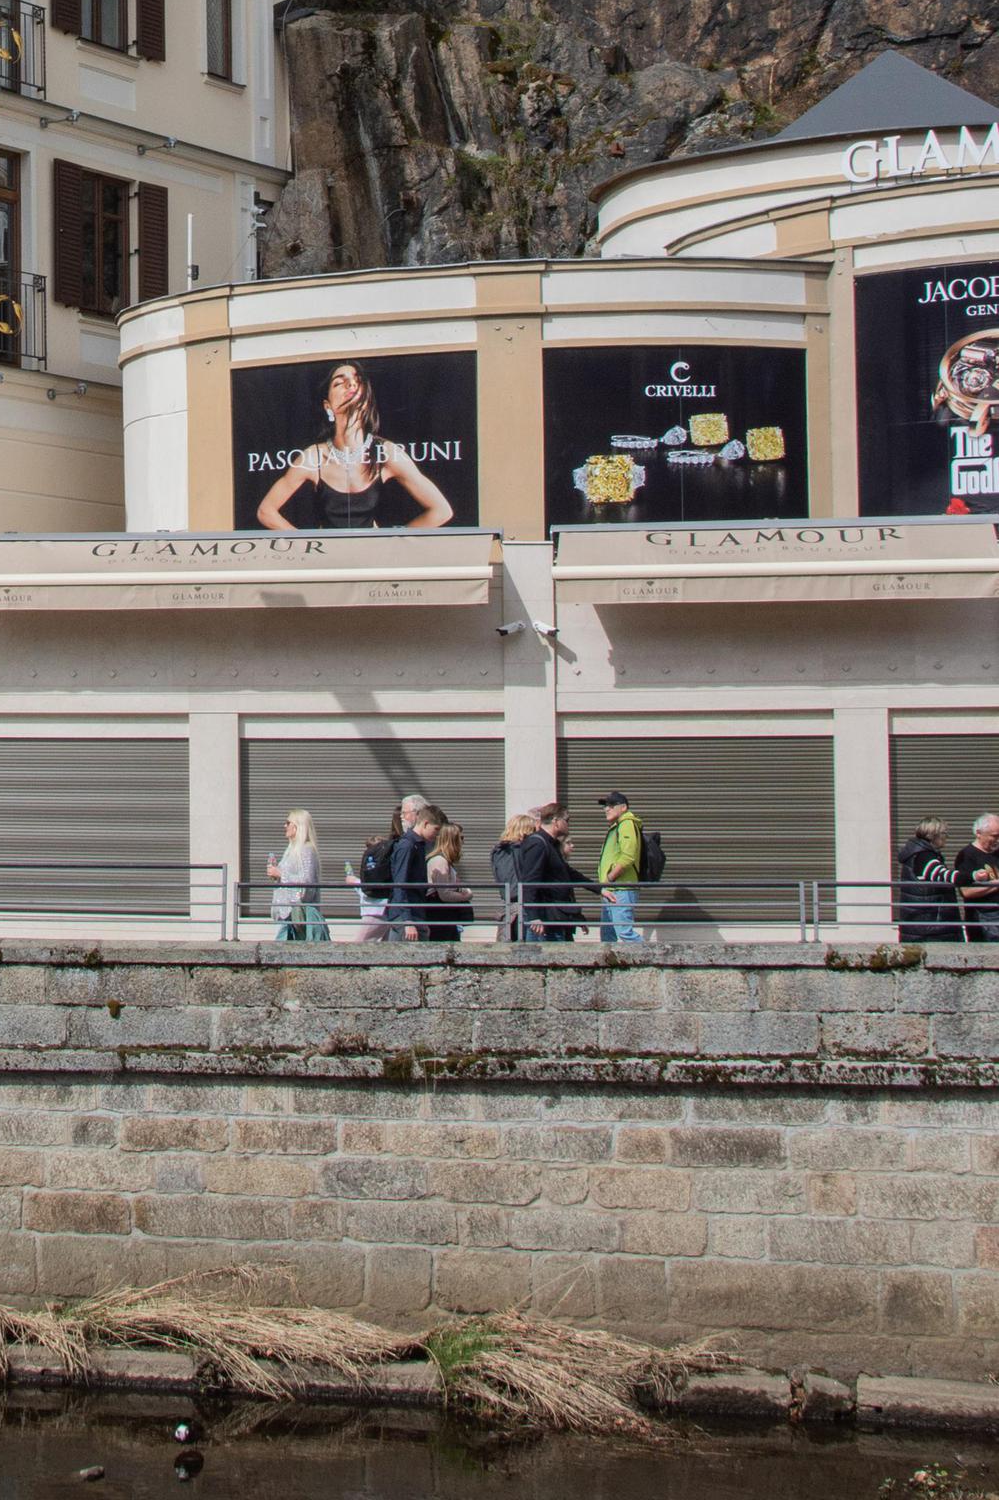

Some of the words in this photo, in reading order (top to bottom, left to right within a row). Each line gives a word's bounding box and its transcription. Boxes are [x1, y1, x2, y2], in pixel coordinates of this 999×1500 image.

[841, 122, 999, 184] GLAM
[645, 385, 717, 398] CRIVELLI
[646, 527, 904, 548] GLAMOUR
[91, 539, 328, 557] GLAMOUR
[622, 586, 680, 596] GLAMOUR
[873, 582, 931, 592] GLAMOUR
[171, 592, 225, 601] GLAMOUR
[368, 588, 423, 598] GLAMOUR
